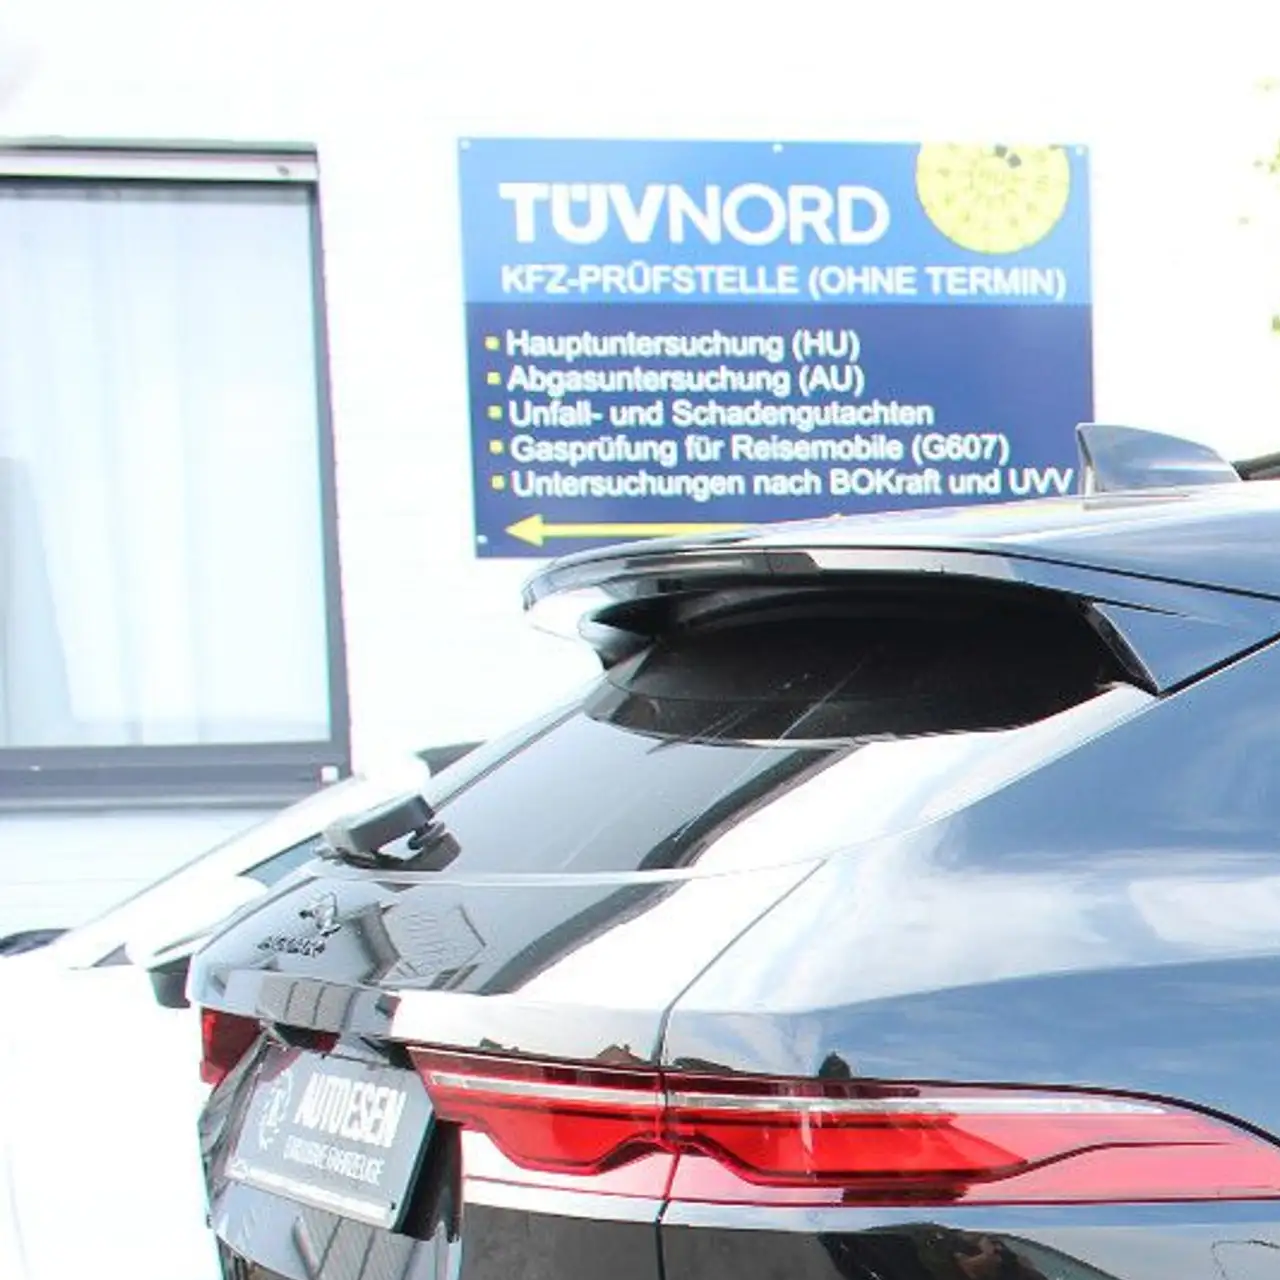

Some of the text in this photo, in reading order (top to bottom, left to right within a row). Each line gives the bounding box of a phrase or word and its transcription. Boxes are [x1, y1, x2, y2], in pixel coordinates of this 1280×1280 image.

[498, 182, 891, 246] TÜVNORD
[501, 260, 1067, 301] KFZ-PRÜFSTELLE (OHNE TERMIN)
[506, 329, 861, 363] Hauptuntersuchung (HU)
[507, 364, 866, 398] Abgasuntersuchung (AU)
[508, 399, 936, 432] Unfall- und Schadengutachten
[510, 432, 1011, 468] Gasprüfung für Reisemobile (G607)
[511, 467, 1075, 503] Untersuchungen nach BOKraft und UVV
